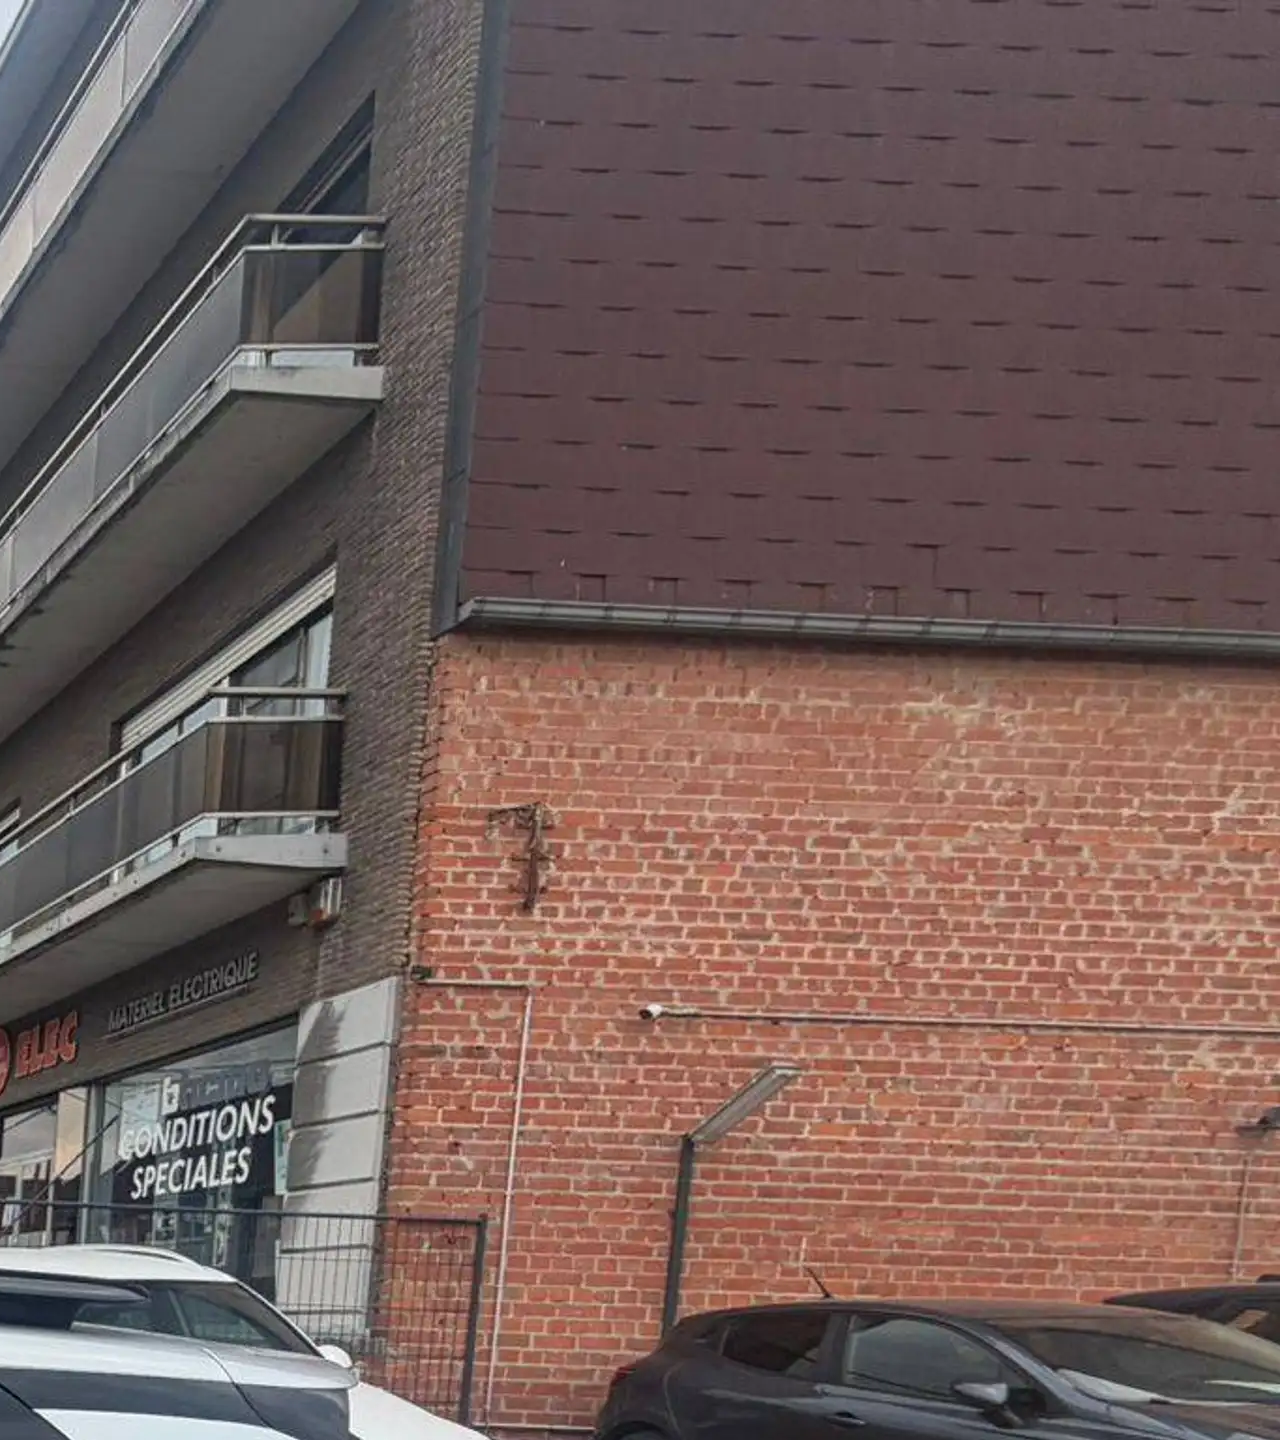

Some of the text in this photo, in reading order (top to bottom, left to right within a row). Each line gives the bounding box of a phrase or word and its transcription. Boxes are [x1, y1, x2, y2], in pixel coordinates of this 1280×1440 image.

[14, 1010, 78, 1079] ELEC
[119, 1095, 276, 1161] CONDITIONS
[131, 1147, 251, 1200] SPECIALES
